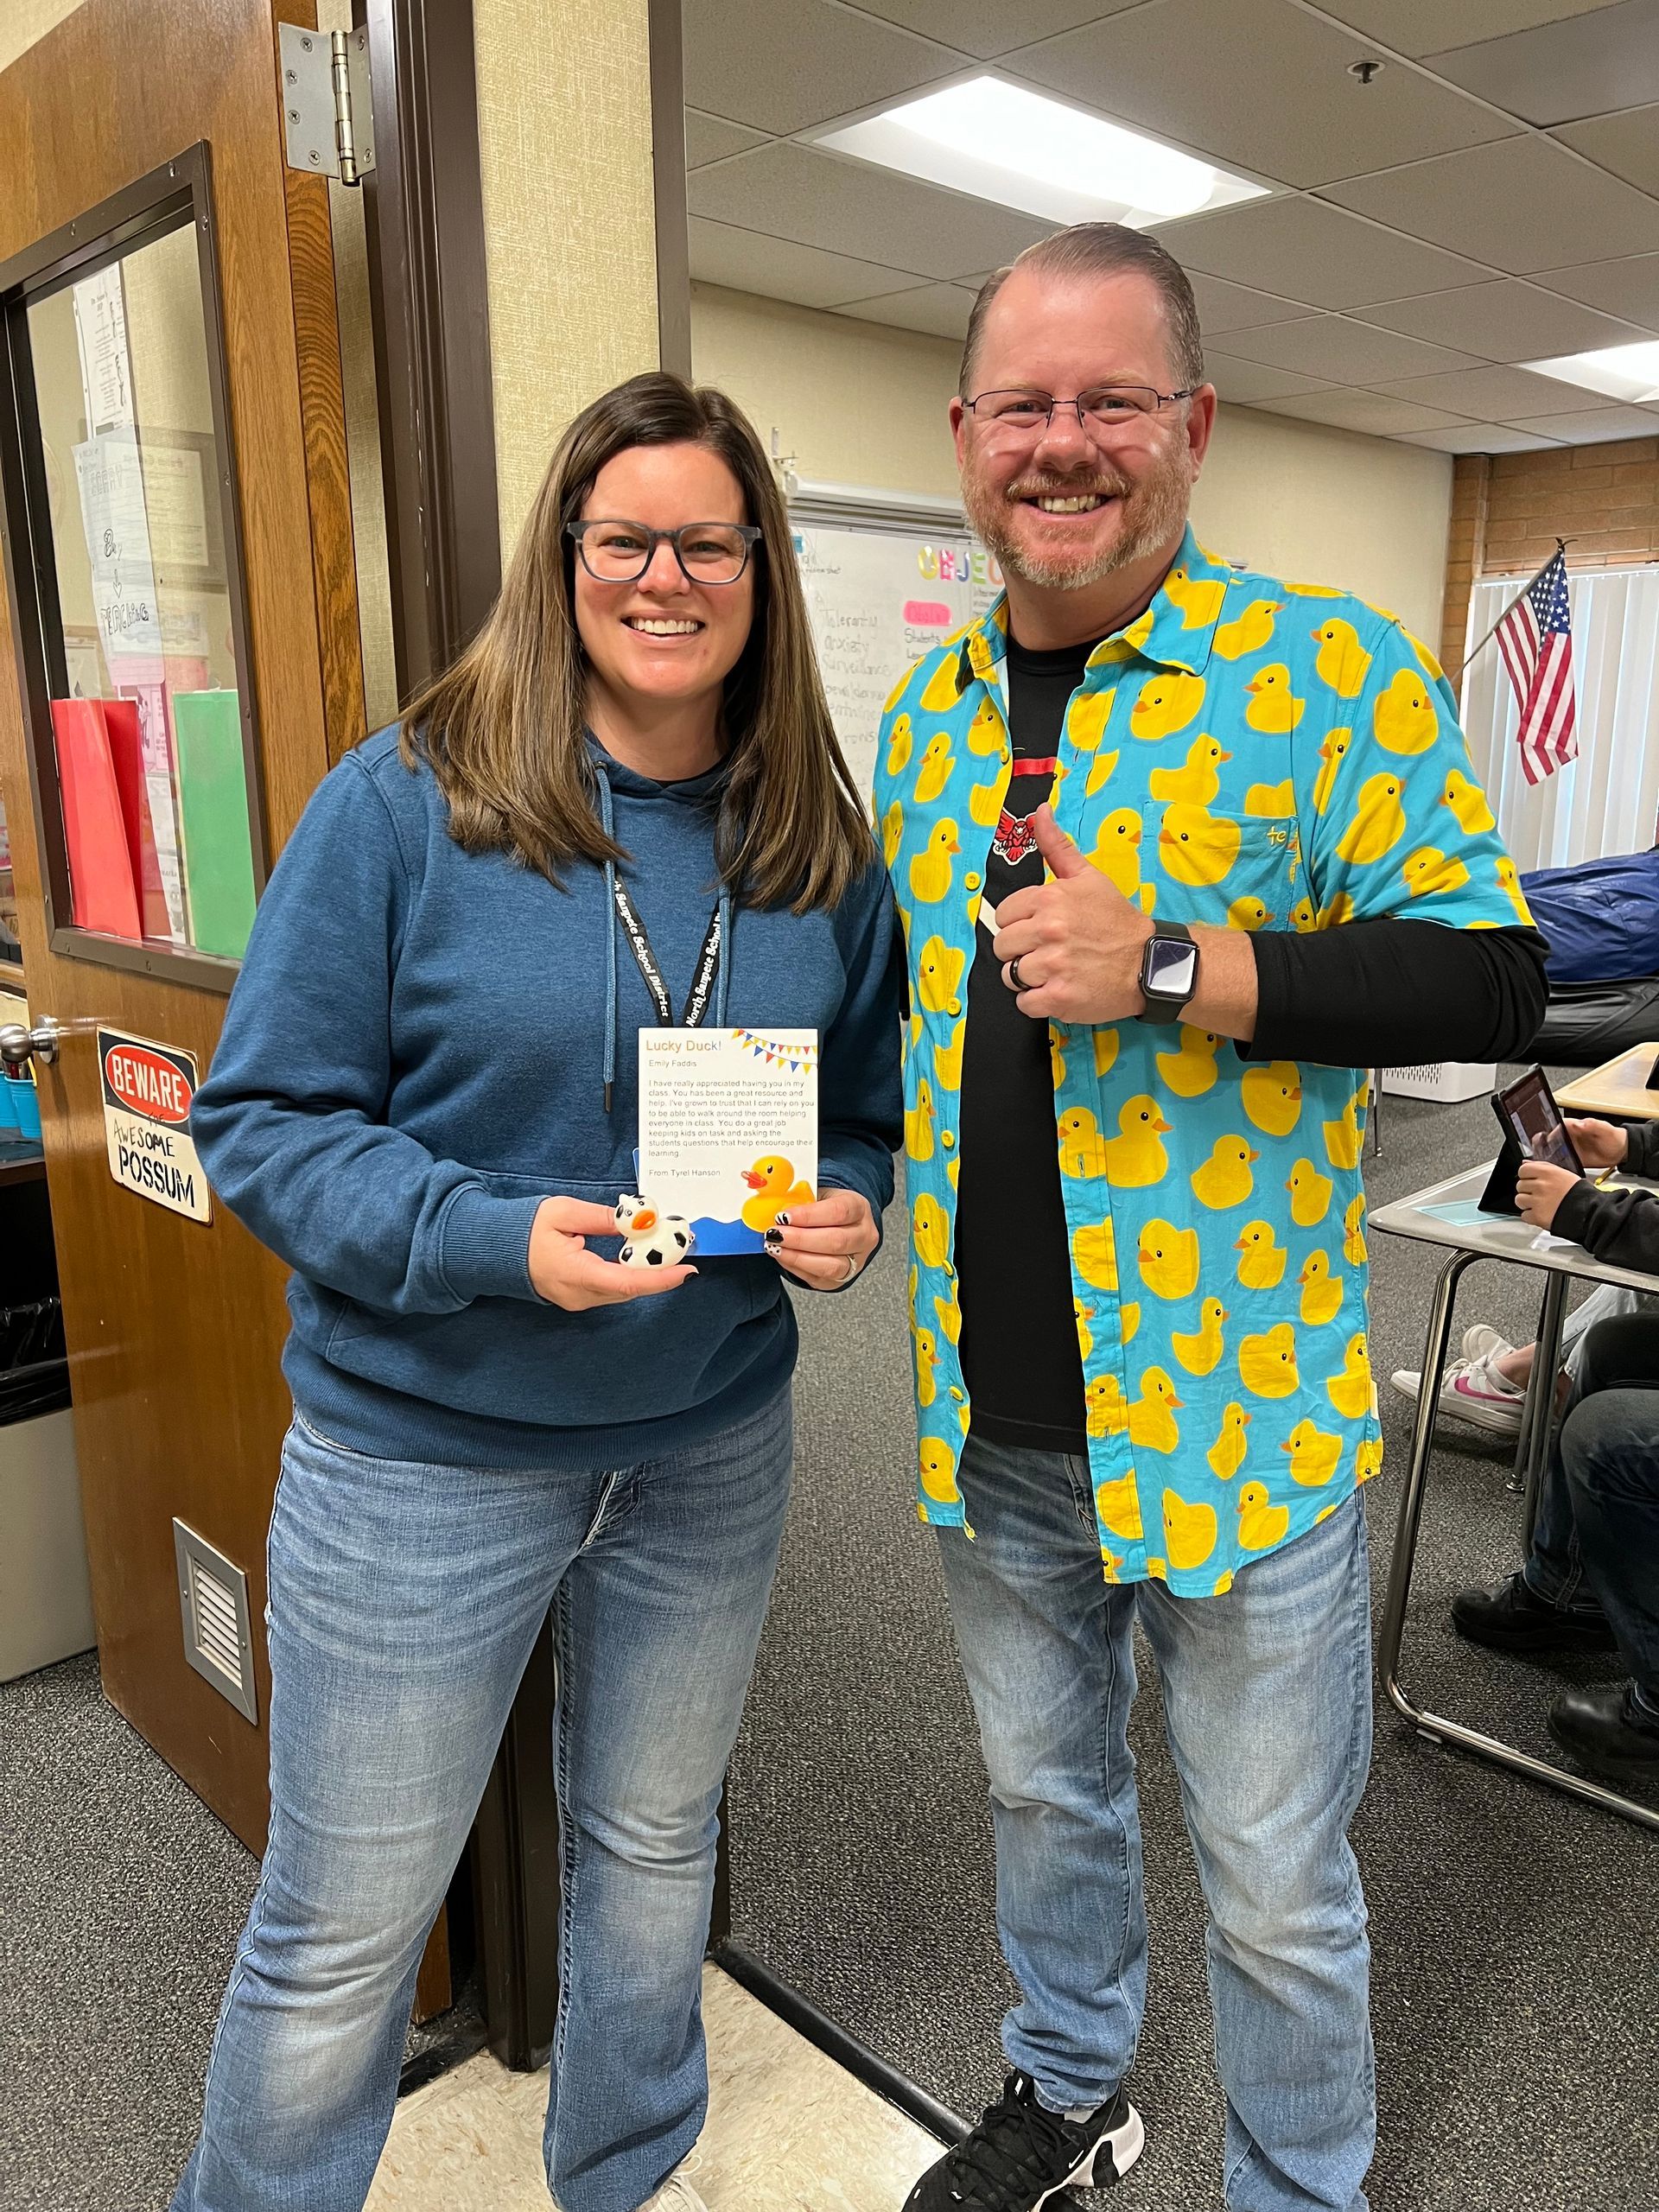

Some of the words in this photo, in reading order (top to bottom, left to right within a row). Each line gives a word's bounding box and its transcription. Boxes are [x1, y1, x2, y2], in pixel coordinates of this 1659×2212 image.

[633, 936, 657, 975] School
[648, 975, 669, 1017] District
[685, 995, 707, 1027] North
[646, 1039, 682, 1053] Lucky
[686, 1039, 721, 1051] Duck!
[649, 1059, 670, 1068] Emily
[111, 1054, 185, 1115] BEWARE
[674, 1080, 695, 1089] really
[696, 1080, 741, 1089] appreciated
[742, 1080, 767, 1089] having
[114, 1118, 175, 1157] AWESOME
[118, 1145, 195, 1208] POSSUM
[671, 1169, 690, 1178] Tyrel
